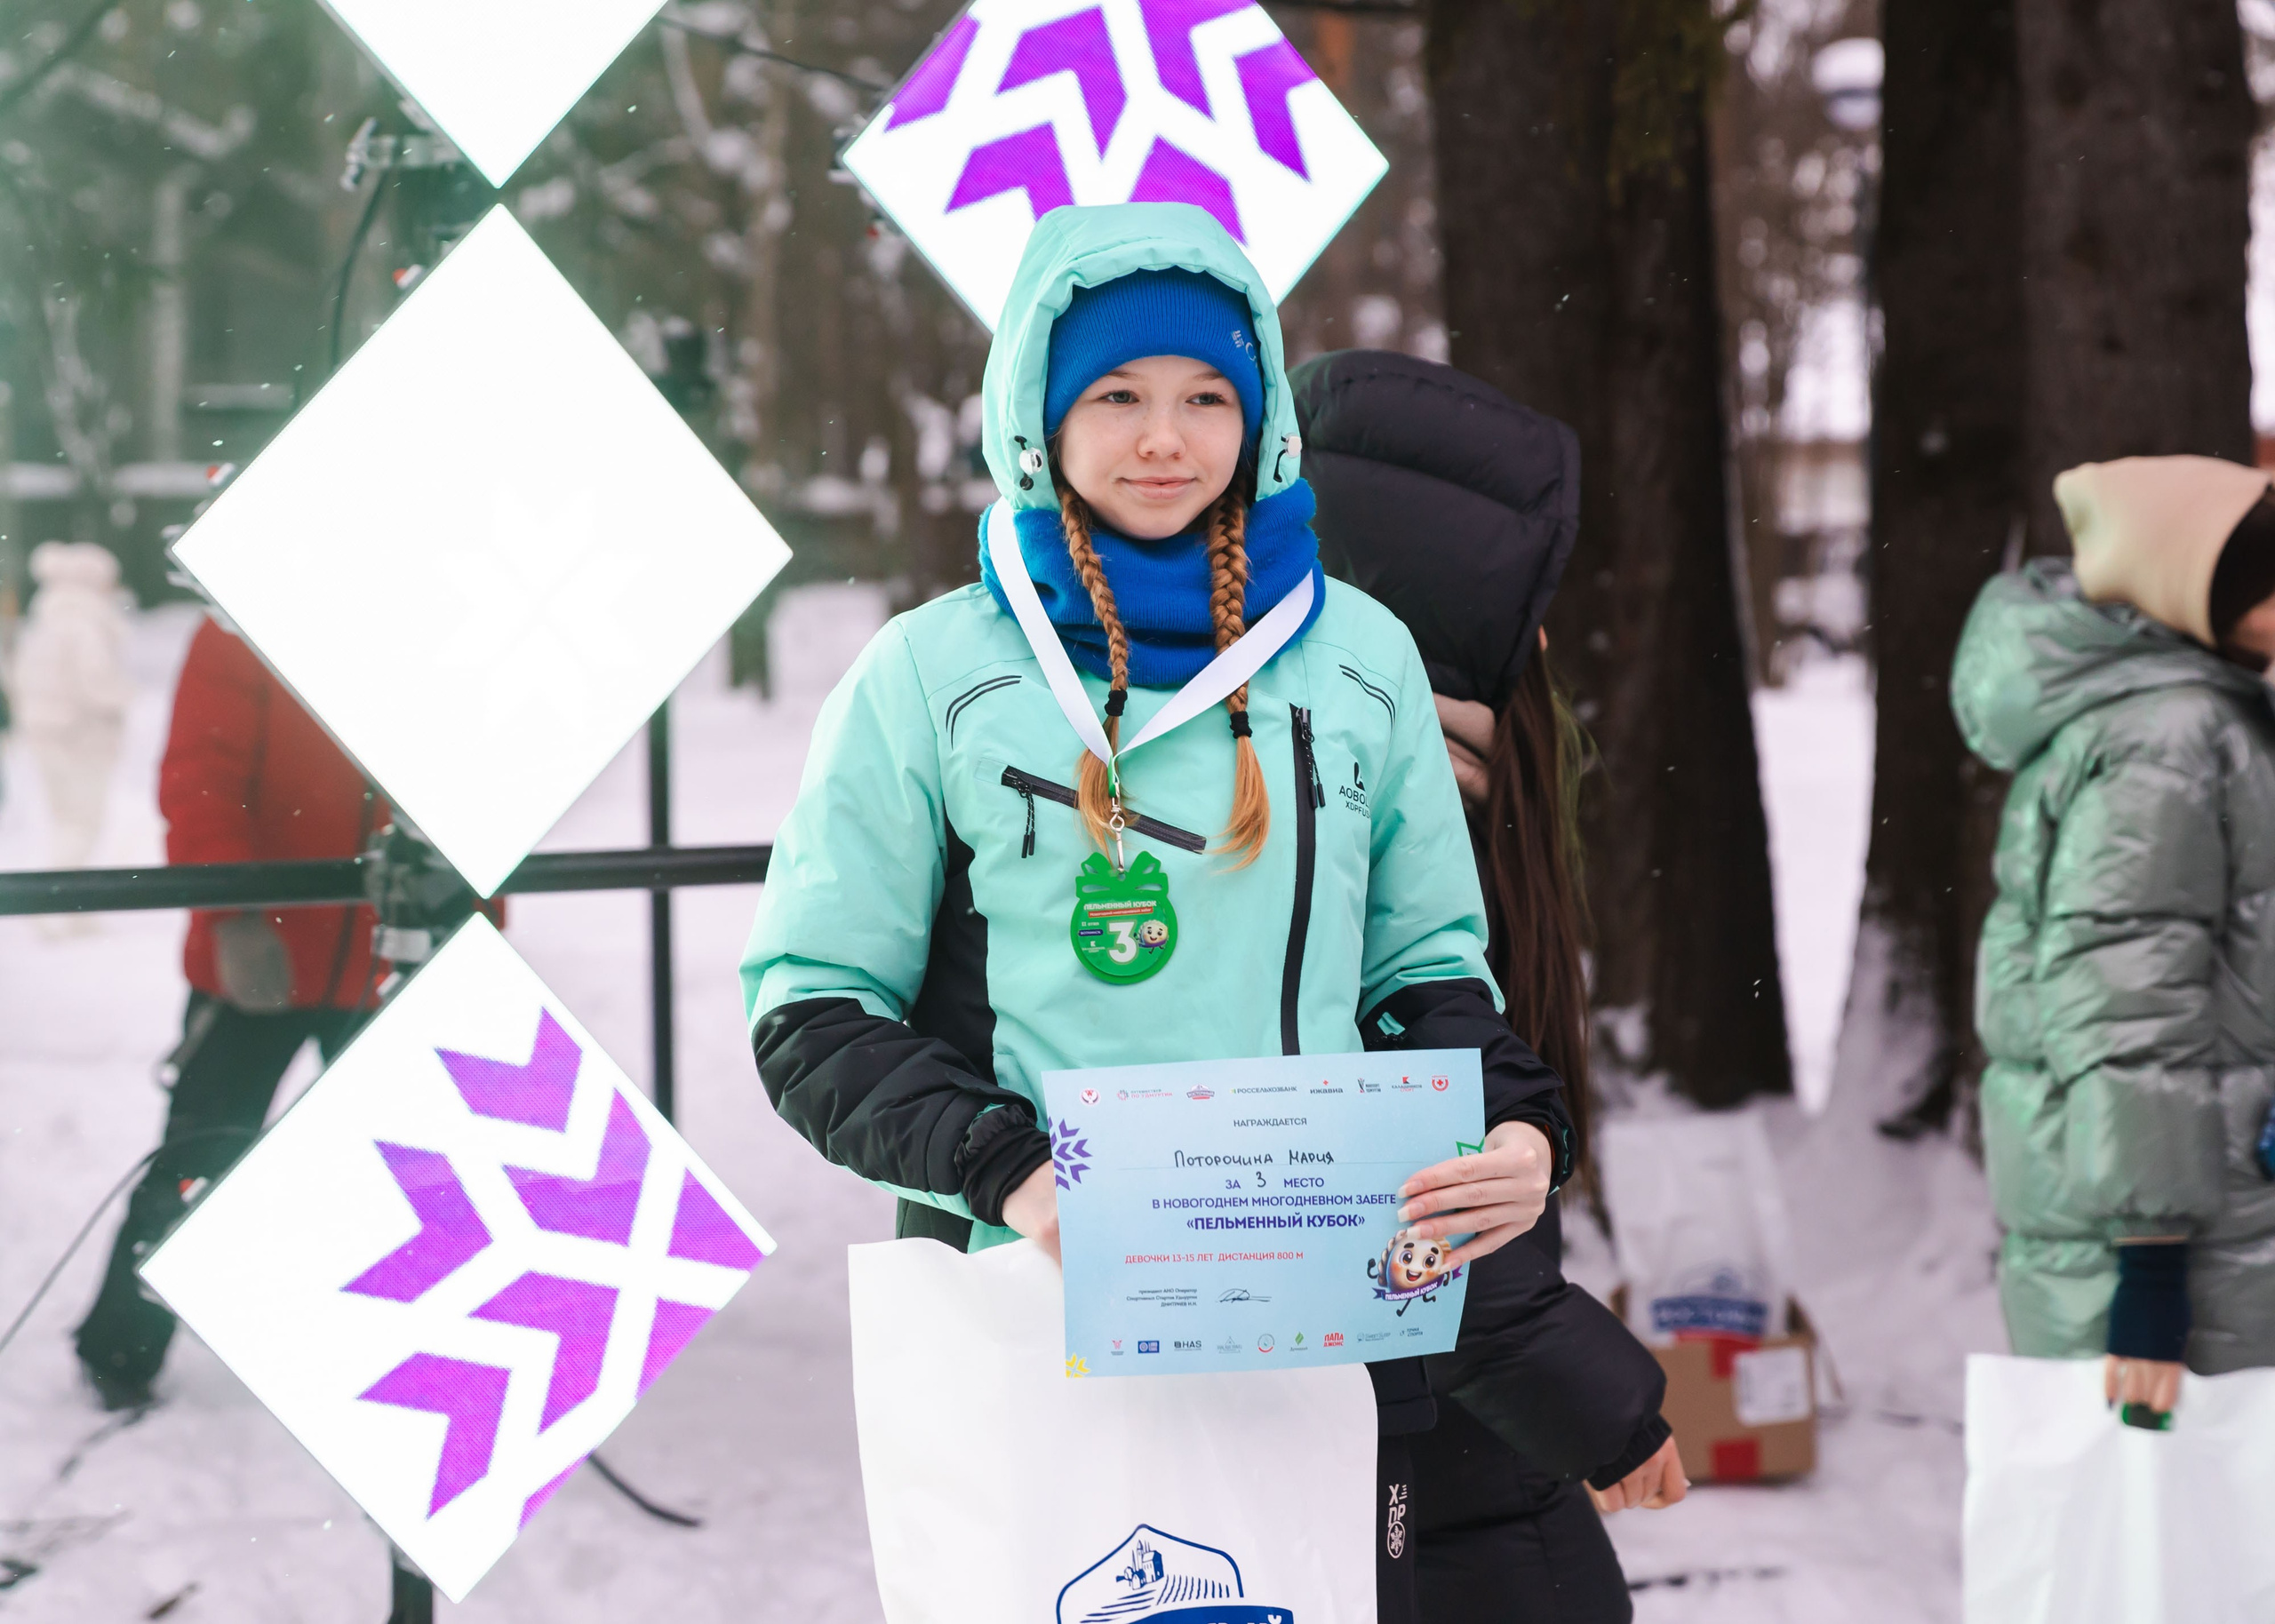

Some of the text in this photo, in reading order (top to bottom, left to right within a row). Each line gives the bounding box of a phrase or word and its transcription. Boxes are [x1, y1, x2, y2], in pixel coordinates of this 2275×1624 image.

[1108, 921, 1137, 962] 3
[1233, 1118, 1307, 1127] НАГРАЖДАЕТСЯ
[1225, 1171, 1324, 1189] ЗА 3 МЕСТО
[1153, 1194, 1396, 1209] В НОВОГОДНЕМ МНОГОДНЕВНОМ ЗАБЕГЕ
[1186, 1213, 1365, 1230] «ПЕЛЬМЕННЫЙ КУБОК»
[1125, 1254, 1170, 1264] ДЕВОЧКИ
[1172, 1254, 1194, 1262] 13-15
[1217, 1252, 1275, 1262] ДИСТАНЦИЯ
[1296, 1251, 1304, 1260] М
[1324, 1332, 1345, 1341] ПАПА
